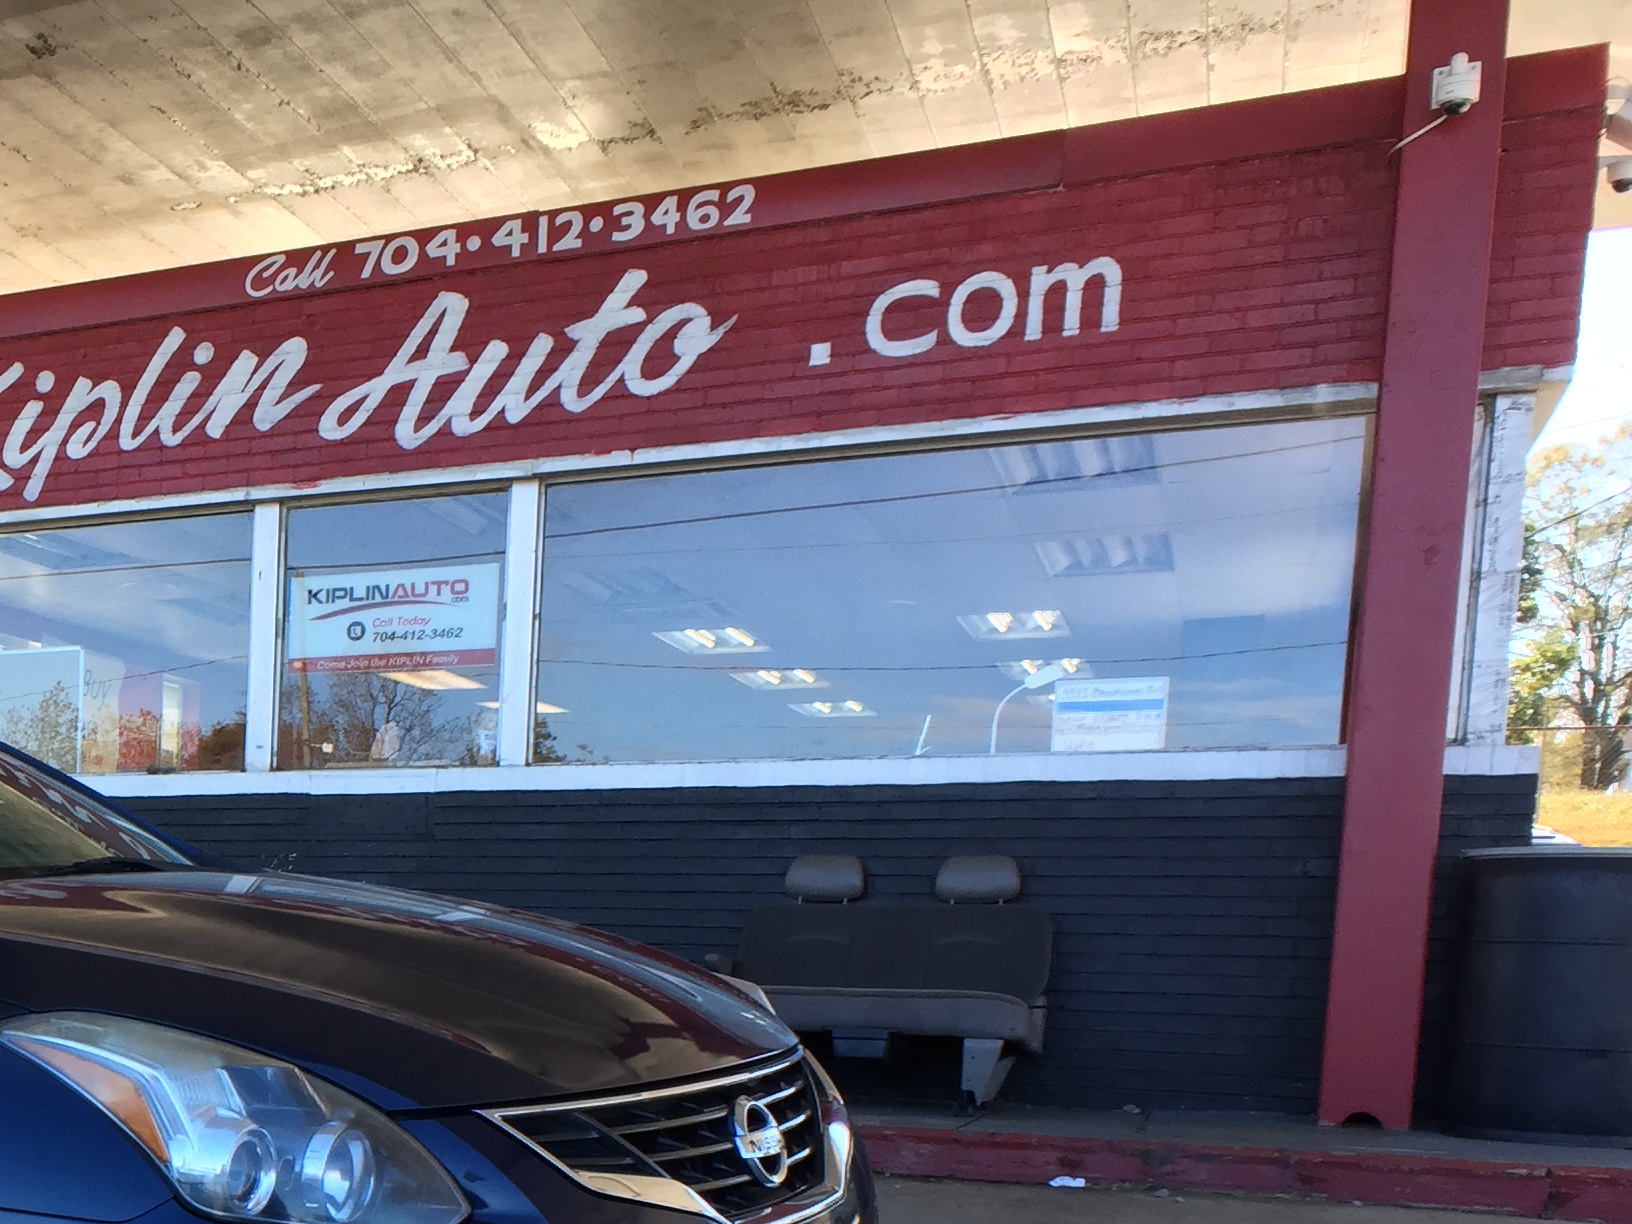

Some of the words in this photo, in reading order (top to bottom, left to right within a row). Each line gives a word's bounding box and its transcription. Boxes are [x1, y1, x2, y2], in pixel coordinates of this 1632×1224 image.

[245, 248, 336, 298] Call
[318, 269, 739, 450] Auto
[372, 617, 393, 628] Call
[397, 615, 431, 627] Today
[372, 627, 464, 642] 704-412-3462
[317, 660, 346, 670] Come
[347, 659, 369, 669] Join
[370, 657, 387, 667] the
[388, 655, 425, 666] KIPLIN
[426, 654, 460, 665] Family
